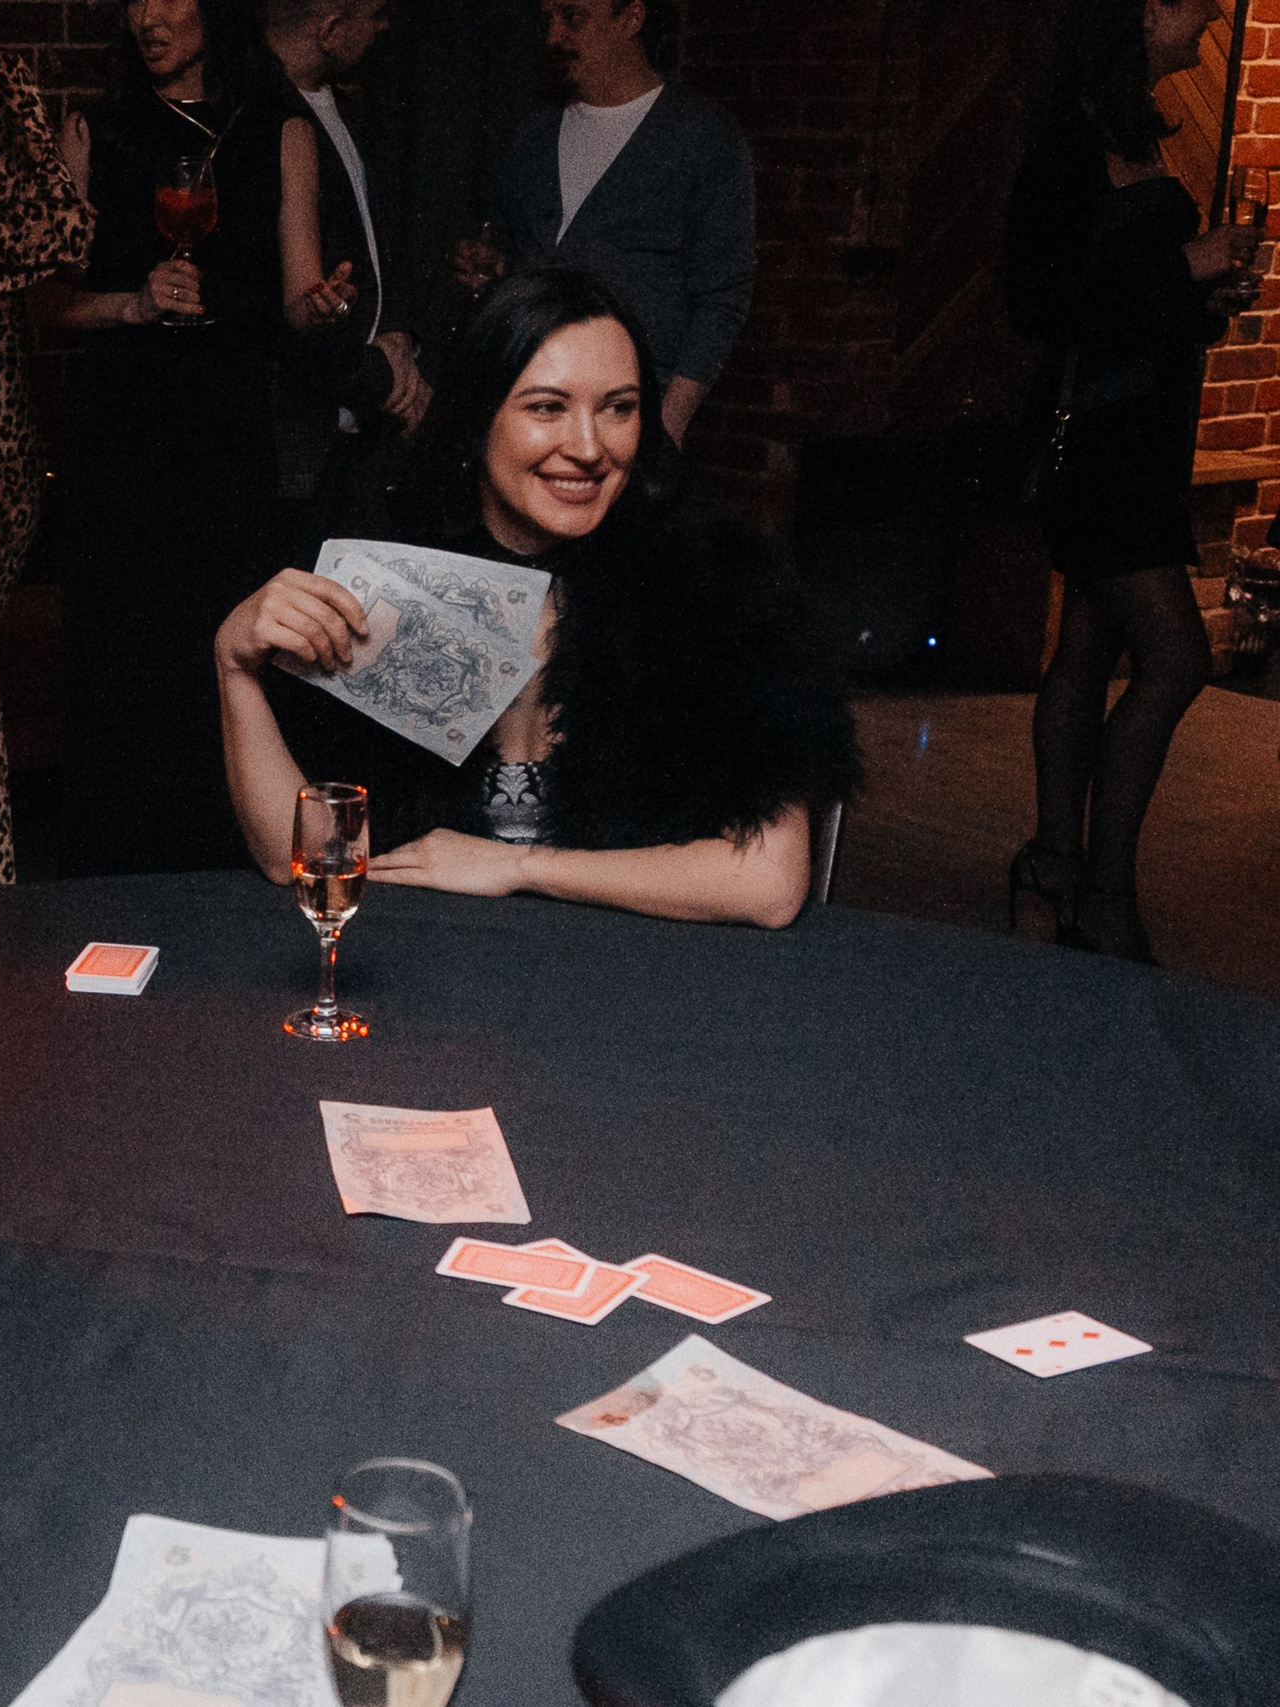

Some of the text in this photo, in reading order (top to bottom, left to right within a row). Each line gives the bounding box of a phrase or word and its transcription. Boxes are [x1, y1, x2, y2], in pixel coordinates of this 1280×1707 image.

[351, 575, 372, 594] 5
[507, 590, 527, 604] 5
[499, 661, 519, 678] 5
[446, 728, 467, 745] 5
